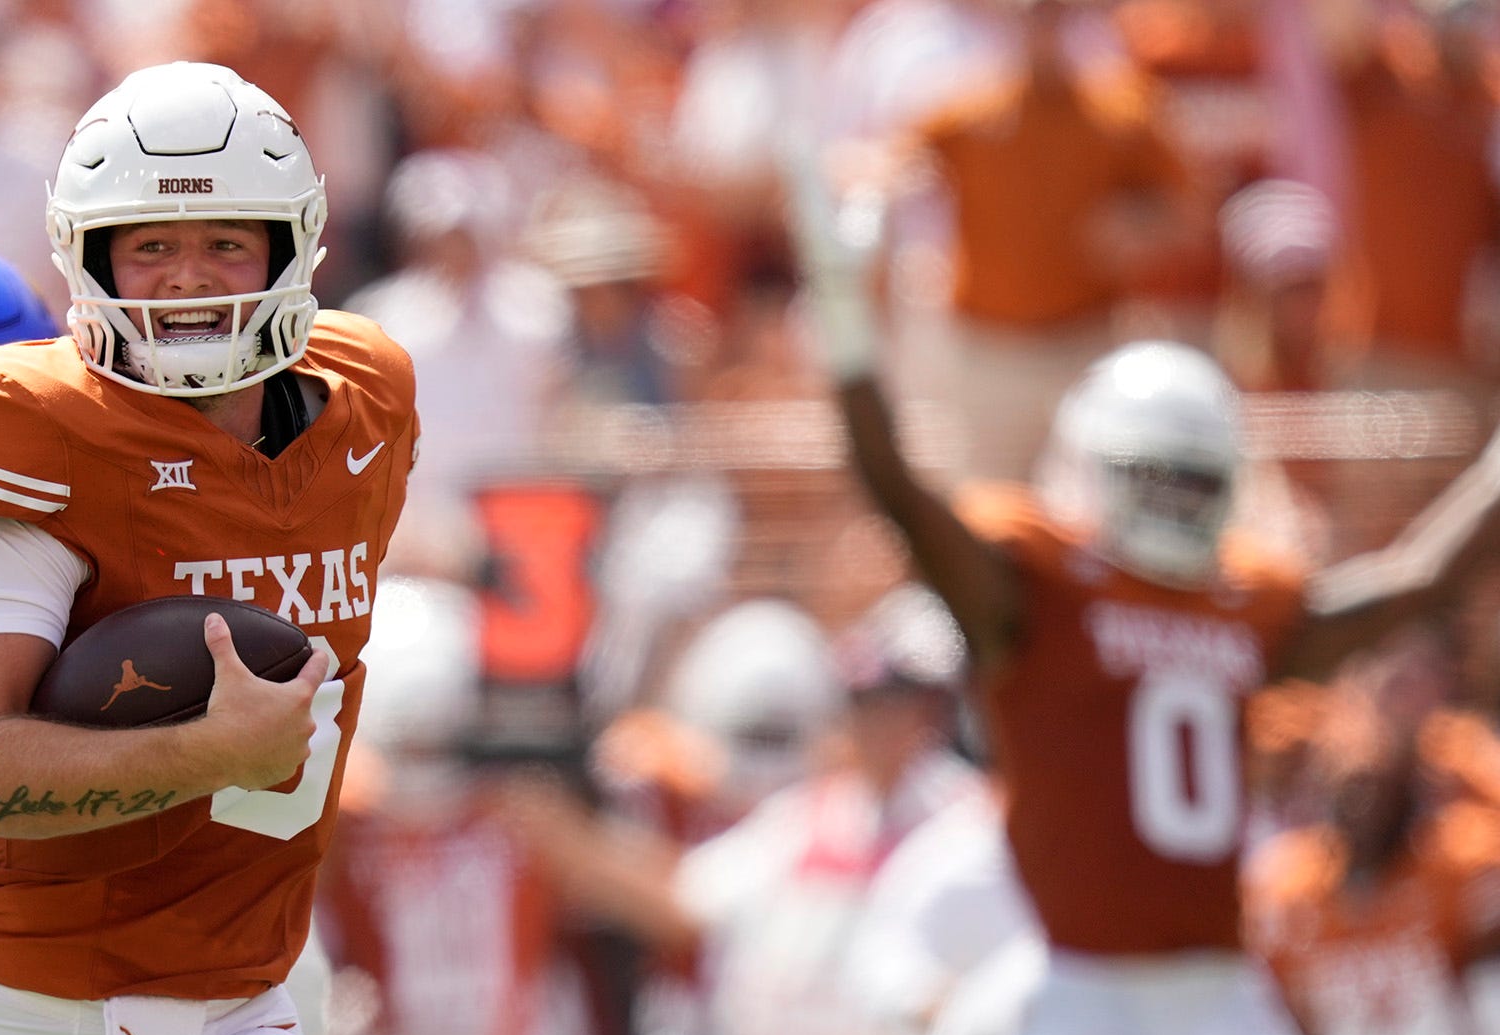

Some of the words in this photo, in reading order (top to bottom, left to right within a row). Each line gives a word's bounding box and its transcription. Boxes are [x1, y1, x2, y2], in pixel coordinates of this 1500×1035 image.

[158, 178, 213, 194] HORNS
[149, 459, 197, 492] XII
[1128, 680, 1242, 862] 0
